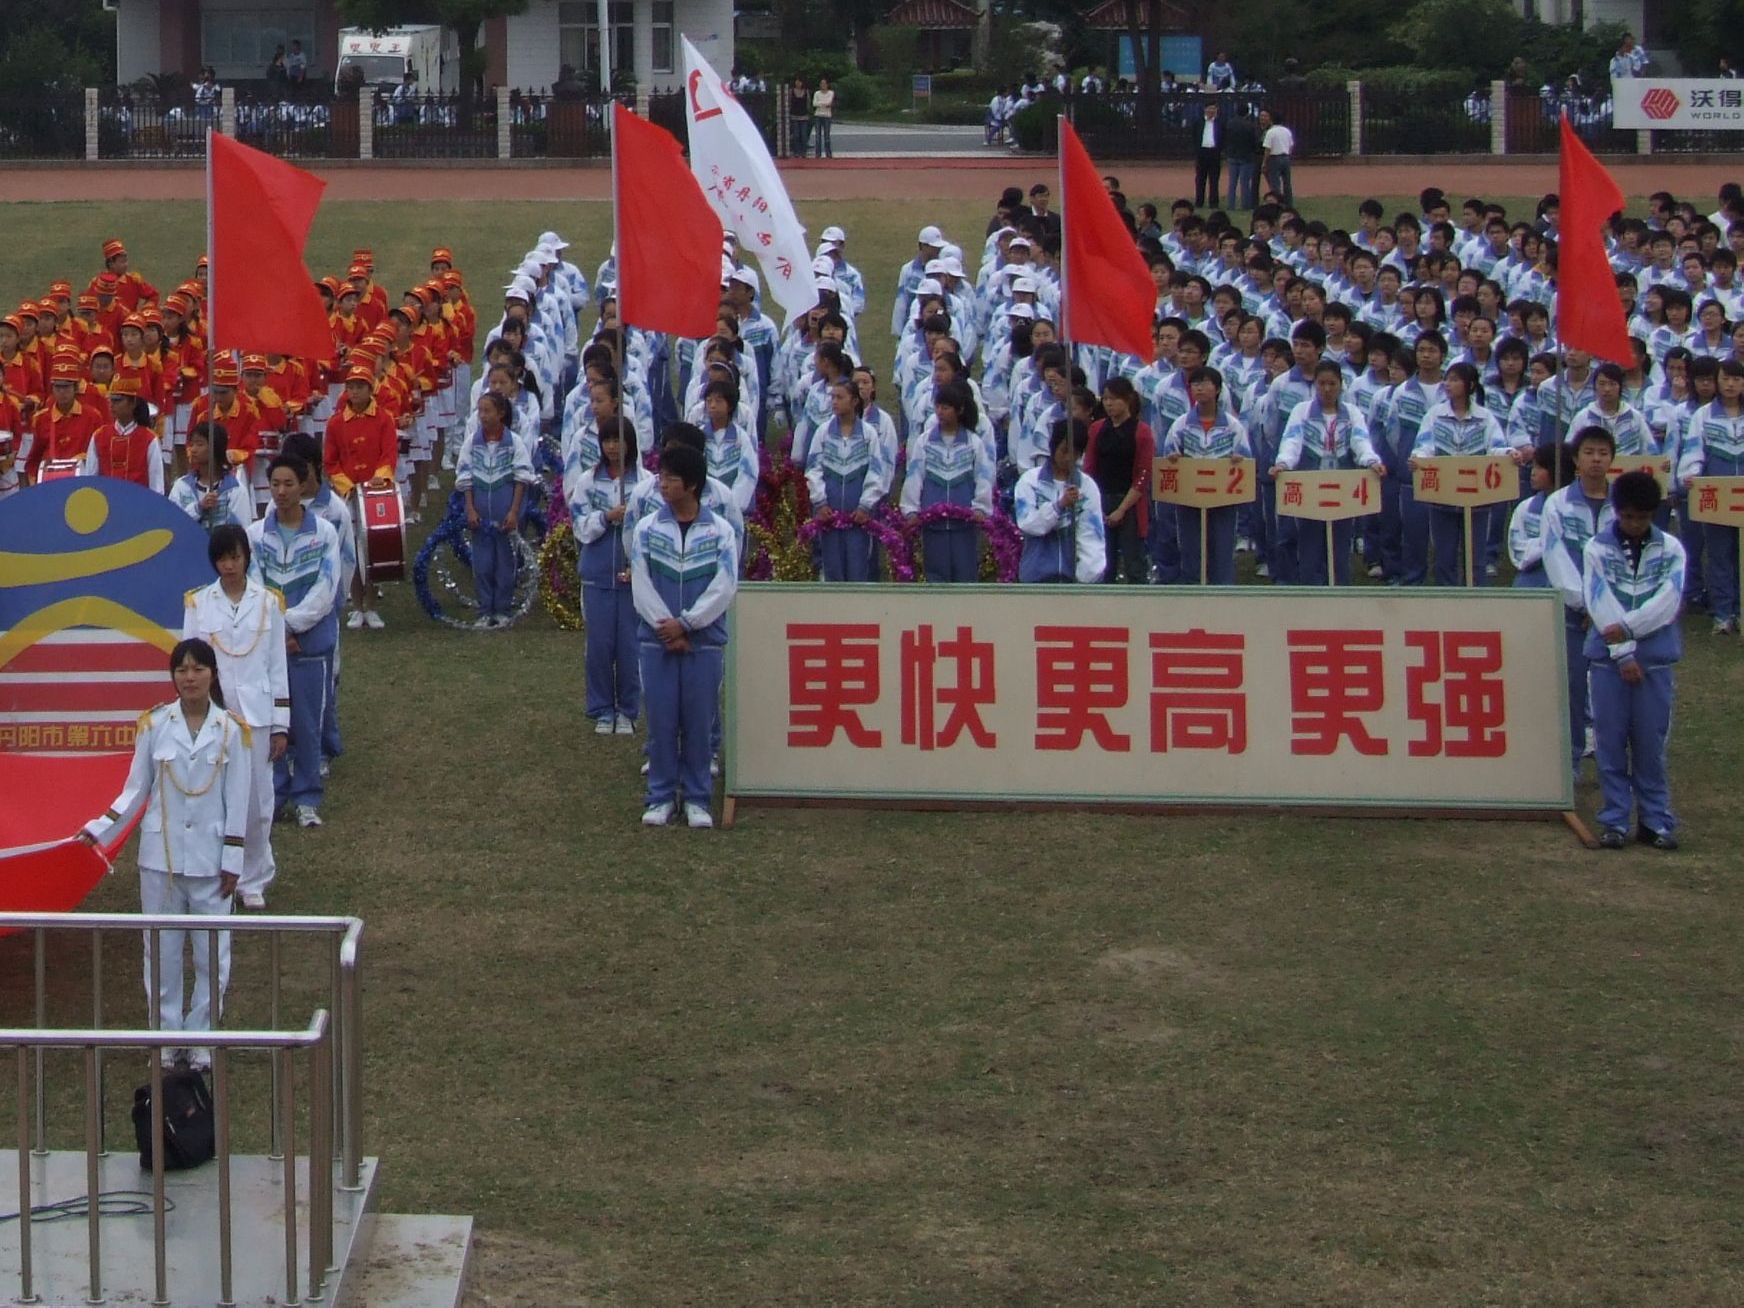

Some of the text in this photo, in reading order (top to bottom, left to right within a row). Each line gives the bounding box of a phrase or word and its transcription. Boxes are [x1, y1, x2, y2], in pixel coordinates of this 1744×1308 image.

[1690, 90, 1742, 108] 沃得
[1690, 112, 1742, 120] WORLD
[1159, 467, 1244, 494] 高二2
[1420, 462, 1502, 493] 高二6
[1283, 477, 1369, 508] 高二4
[786, 622, 1507, 758] 更快更高更强
